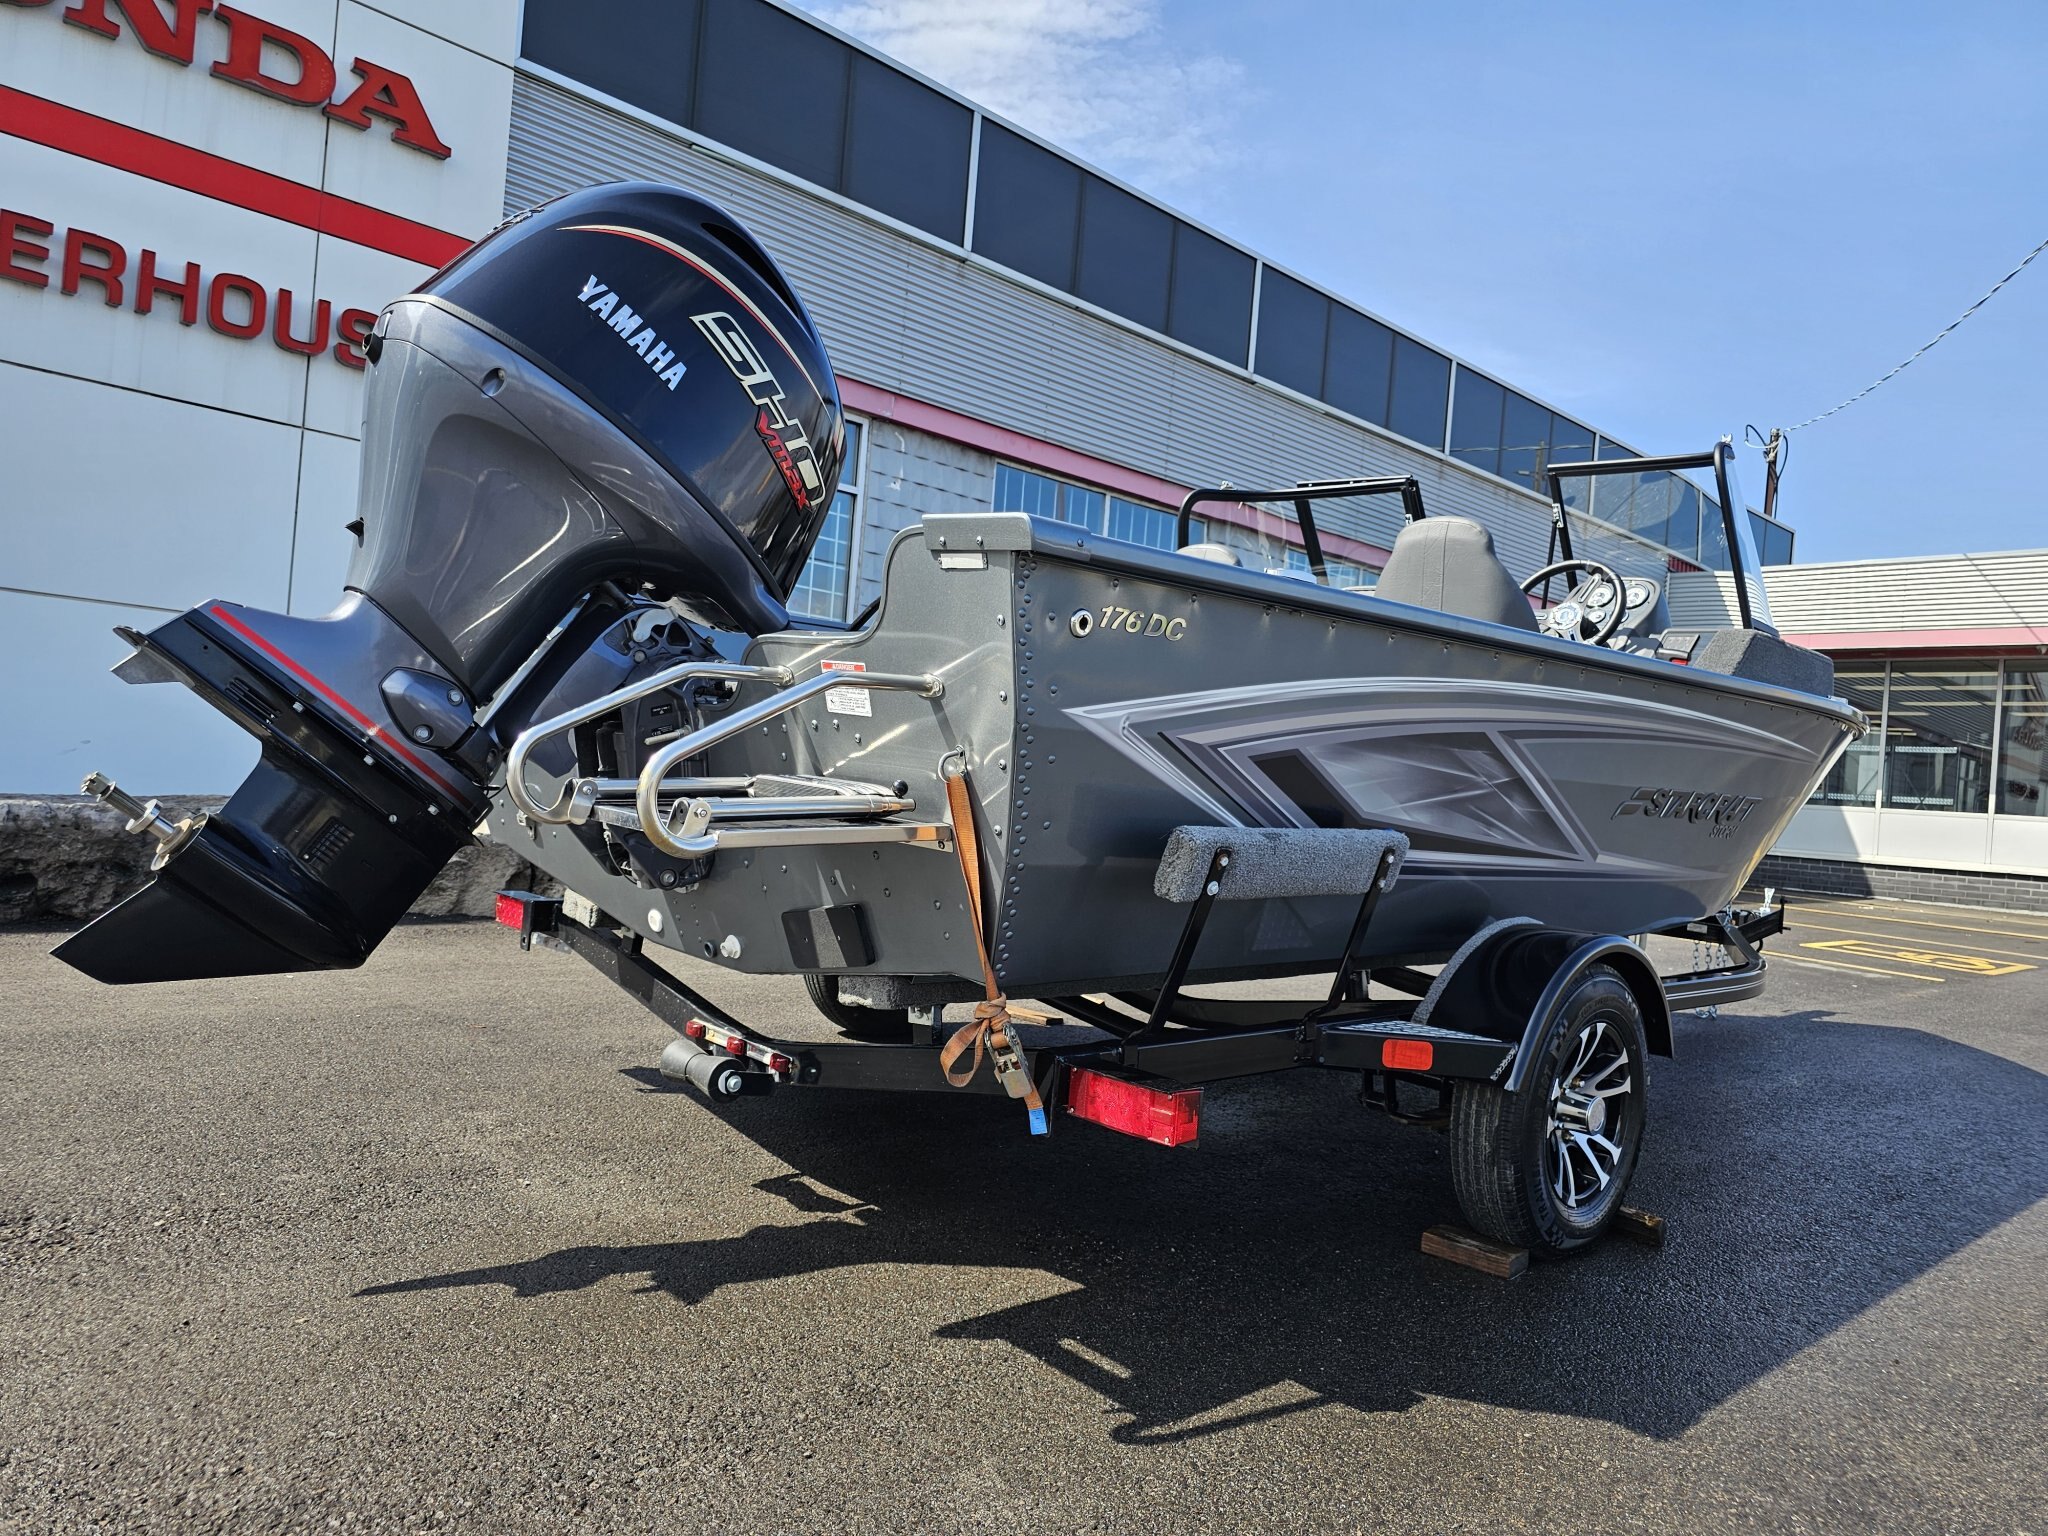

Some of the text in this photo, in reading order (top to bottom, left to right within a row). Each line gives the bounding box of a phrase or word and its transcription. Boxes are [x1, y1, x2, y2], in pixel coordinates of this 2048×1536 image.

[0, 0, 452, 161] NDA
[577, 274, 688, 391] YAMAHA
[1099, 605, 1187, 641] 176 DC
[1643, 787, 1764, 825] STARCRAFT
